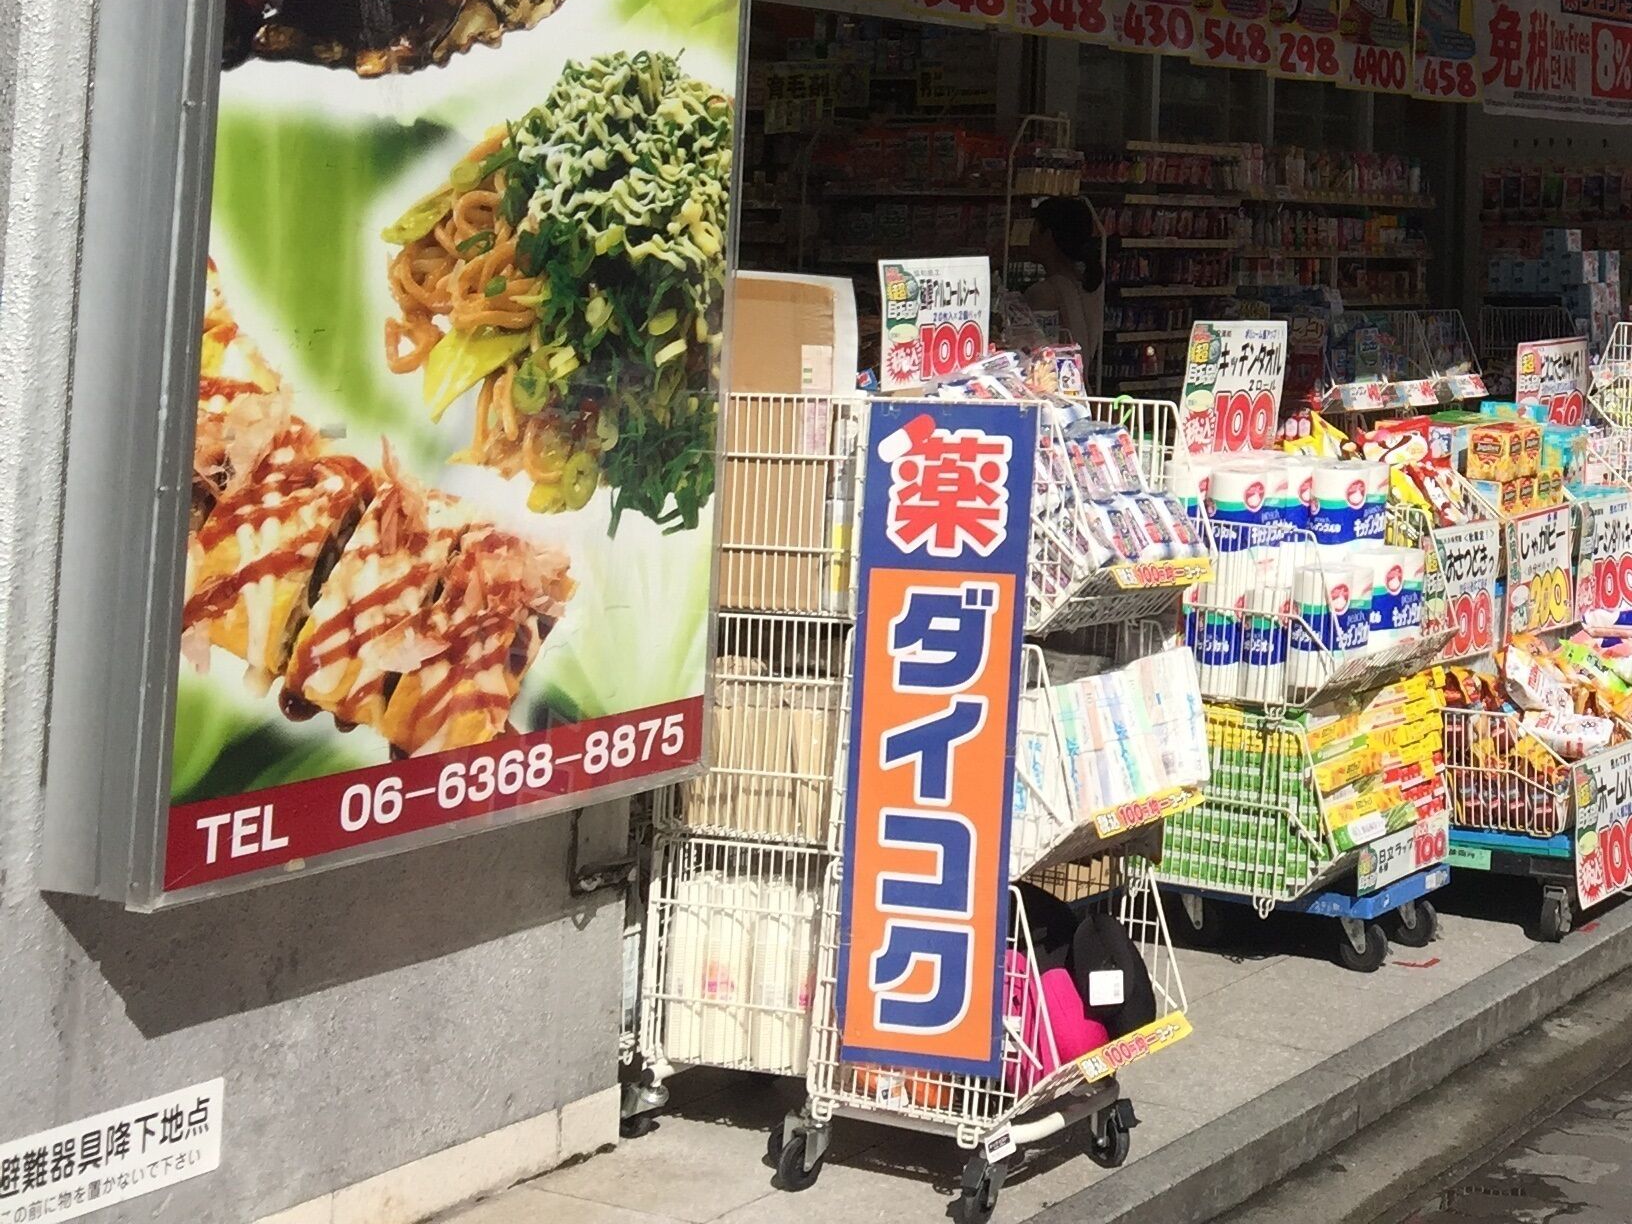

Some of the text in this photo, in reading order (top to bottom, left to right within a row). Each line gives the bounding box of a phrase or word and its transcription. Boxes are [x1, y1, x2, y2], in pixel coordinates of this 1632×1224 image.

[1123, 1, 1194, 50] 430
[1204, 18, 1271, 64] 548
[1280, 32, 1339, 76] 298
[1423, 59, 1477, 98] 458
[919, 321, 984, 381] 100
[1213, 389, 1276, 453] 100
[878, 413, 1013, 558] 薬
[196, 712, 684, 864] TEL 06-6368-8875
[869, 580, 999, 1036] ダイコク
[1414, 827, 1447, 869] 100
[0, 1097, 210, 1199] 避難器具降下地点
